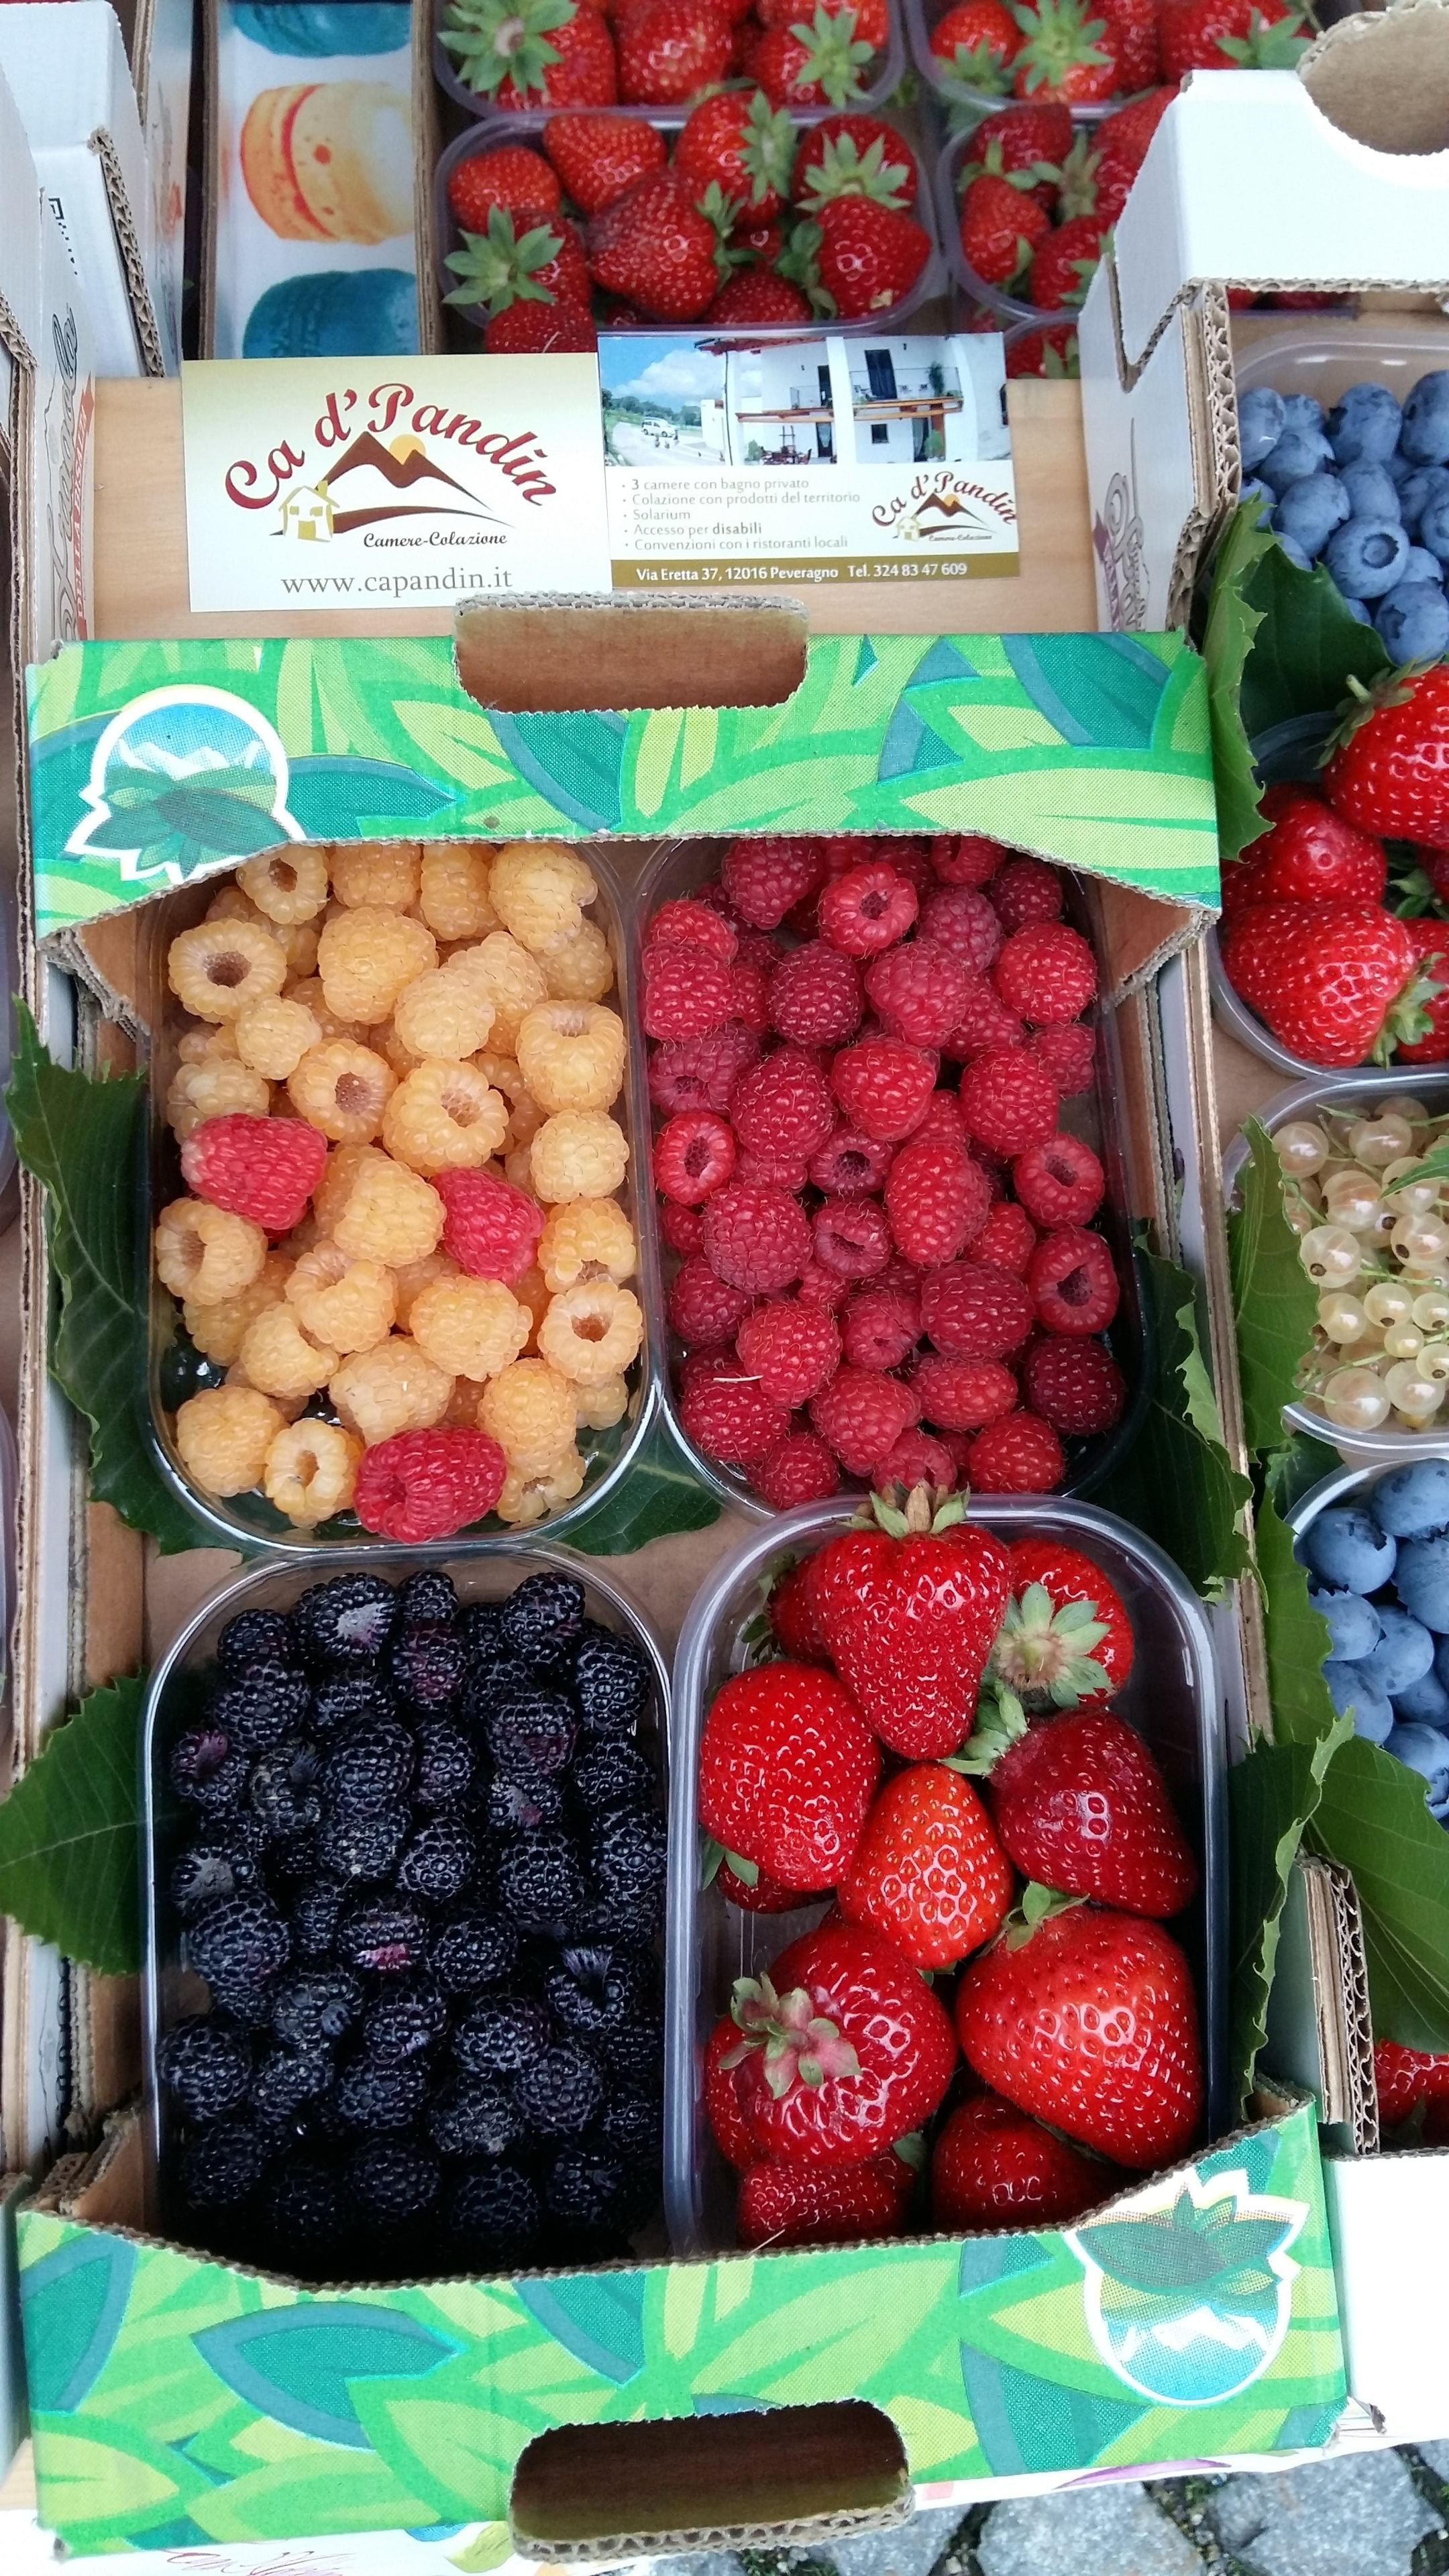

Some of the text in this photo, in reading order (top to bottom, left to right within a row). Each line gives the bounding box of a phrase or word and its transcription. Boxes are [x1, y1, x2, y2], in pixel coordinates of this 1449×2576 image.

[225, 439, 305, 509] Ca
[631, 478, 809, 494] 3 camere con bagno privato
[633, 491, 860, 508] Colazione con prodotti del territorio
[633, 508, 691, 520] Solarium
[872, 496, 907, 527] Ca
[634, 522, 762, 539] Accesso per disabili
[364, 531, 508, 547] Camere-Colazione
[635, 535, 848, 551] Convenzioni con i ristoranti locali
[73, 521, 85, 617] DELLA
[636, 566, 839, 582] Via Eretta 37, 12016 Peveragno
[848, 562, 967, 578] Tel. 324 83 47 609
[280, 566, 514, 598] www.capandin.it
